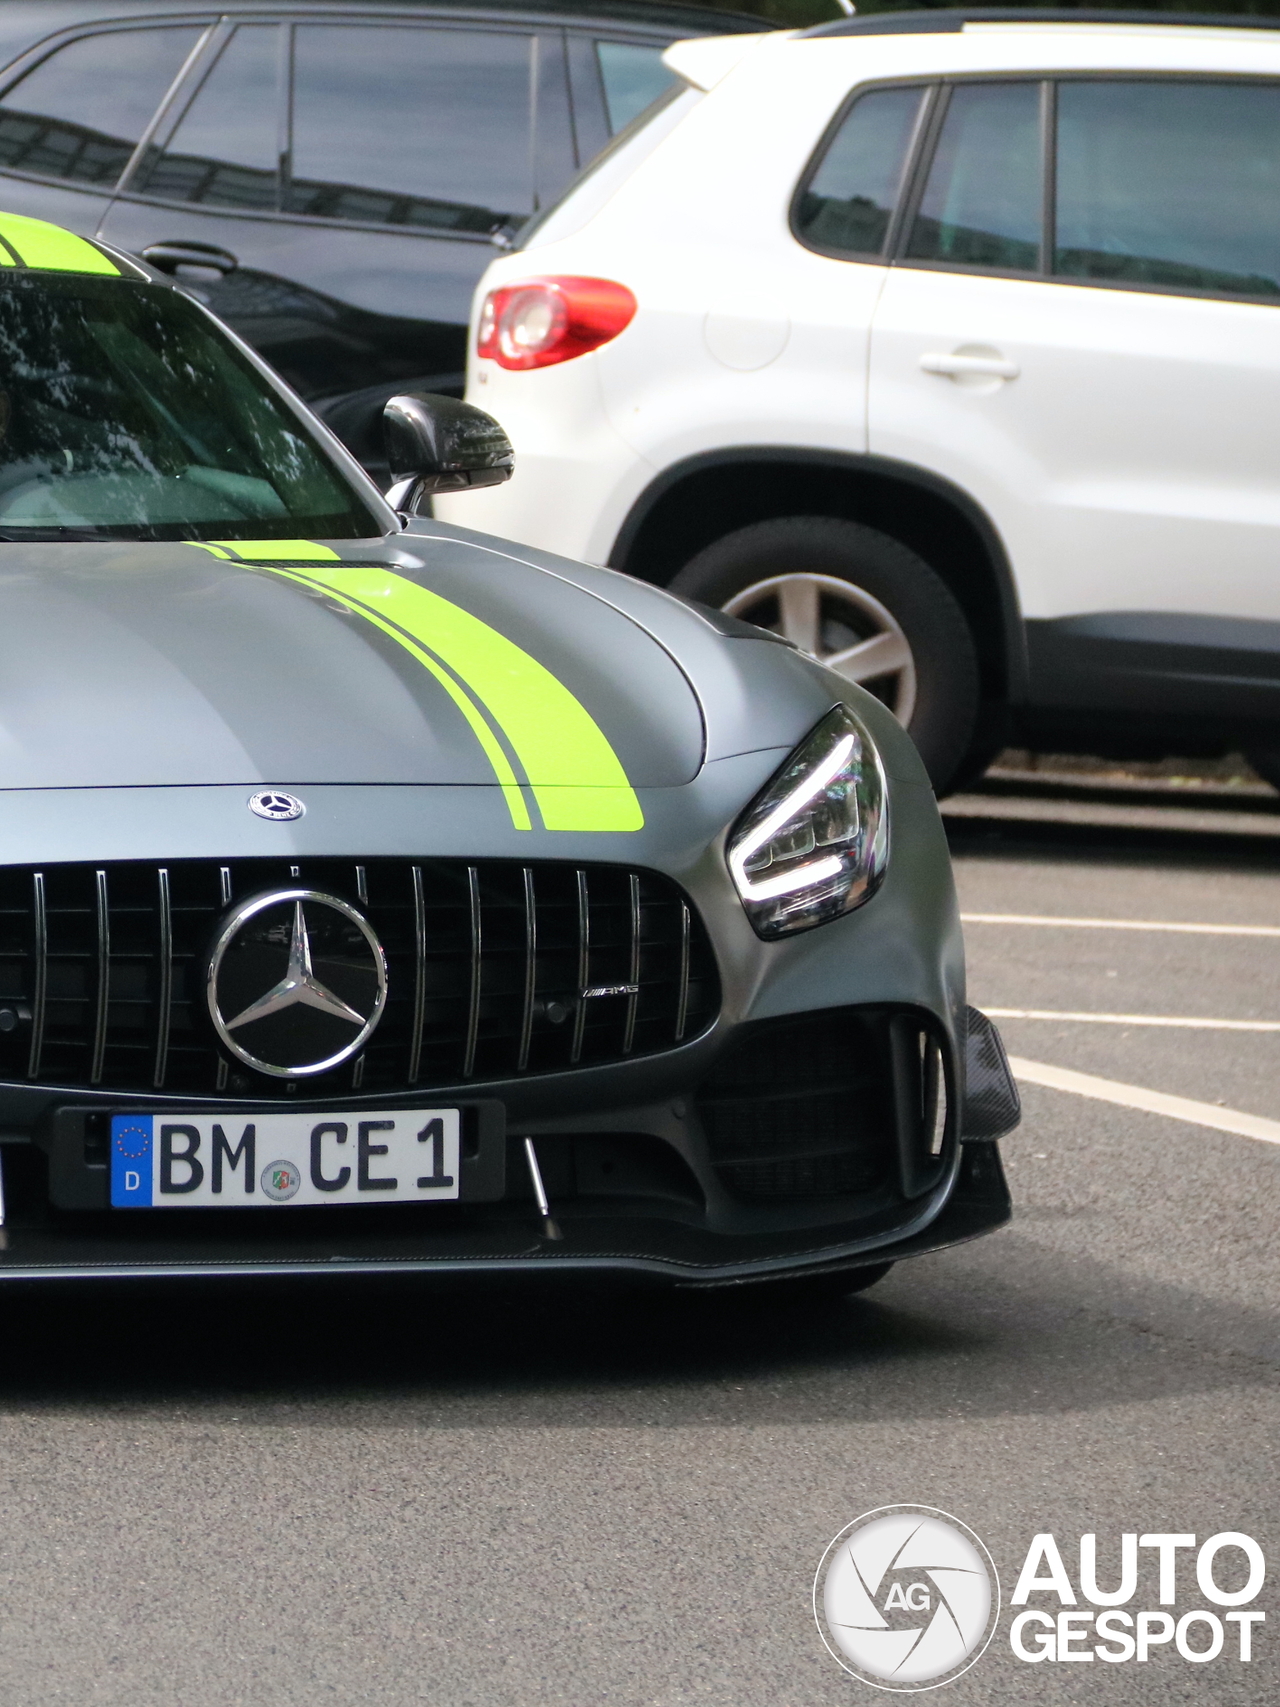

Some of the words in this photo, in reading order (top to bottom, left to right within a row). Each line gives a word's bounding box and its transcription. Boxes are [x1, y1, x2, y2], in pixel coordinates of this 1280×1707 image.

[599, 985, 639, 996] AMG
[159, 1123, 256, 1194] BM
[310, 1120, 398, 1192] CE
[417, 1117, 454, 1188] 1
[125, 1171, 140, 1191] D
